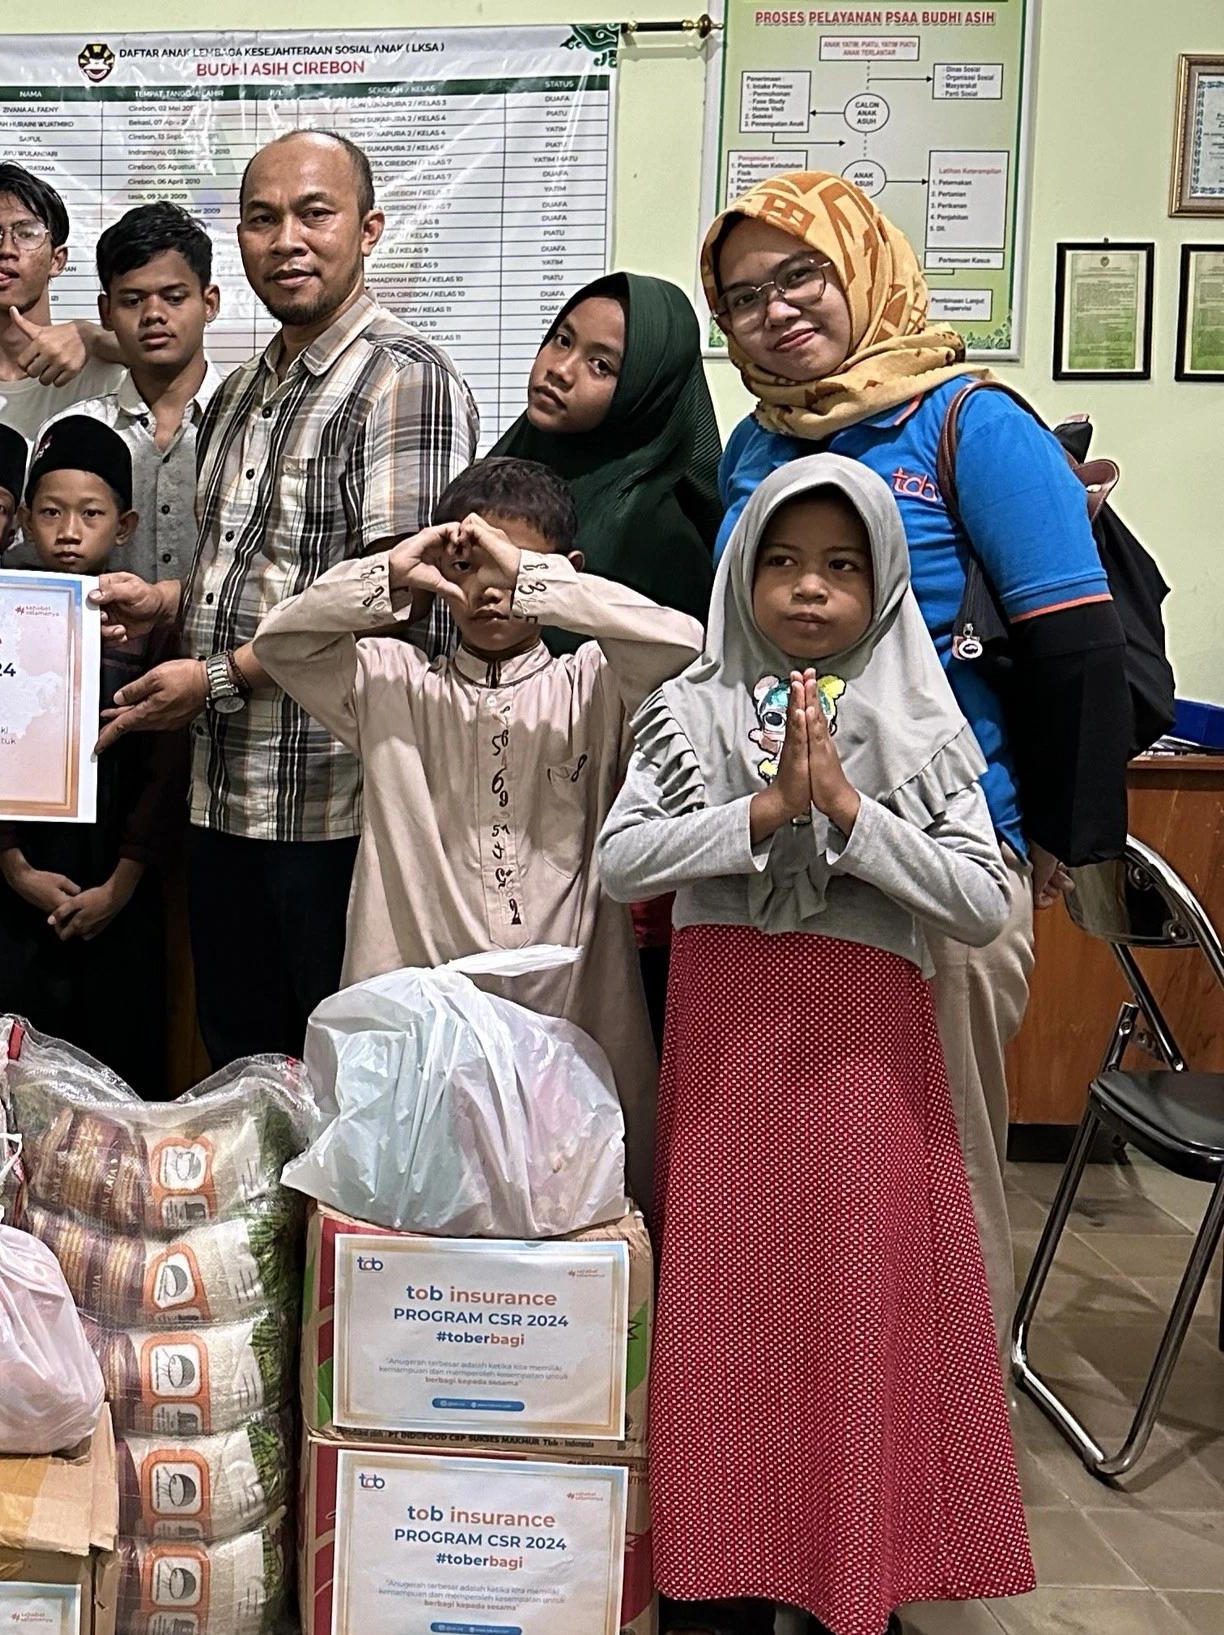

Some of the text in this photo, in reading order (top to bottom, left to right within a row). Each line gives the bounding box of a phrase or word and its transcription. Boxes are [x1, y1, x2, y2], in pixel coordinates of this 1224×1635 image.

[755, 11, 995, 24] PROSES PELAYANAN PSAA BUDHI ASIH
[119, 49, 159, 58] DAFTAR
[161, 48, 189, 57] ANAK
[193, 48, 242, 57] LEMBAGA
[244, 46, 332, 57] KESEJAHTERAAN
[335, 45, 373, 55] SOSIAL
[374, 44, 404, 54] ANAK
[196, 60, 365, 77] BUDHI ASIH CIREBON
[19, 90, 43, 98] NAMA
[411, 85, 436, 93] KELAS
[544, 80, 574, 89] STATUS
[367, 145, 406, 153] SUKAPURA
[892, 466, 937, 502] tob
[357, 1256, 384, 1272] tob
[406, 1285, 557, 1306] tob insurance
[394, 1308, 569, 1327] PROGRAM CSR 2024
[436, 1331, 525, 1348] #toberbagi
[359, 1473, 385, 1489] tob
[408, 1505, 556, 1528] tob insurance
[394, 1529, 567, 1550] PROGRAM CSR 2024
[436, 1552, 523, 1571] #toberbagi
